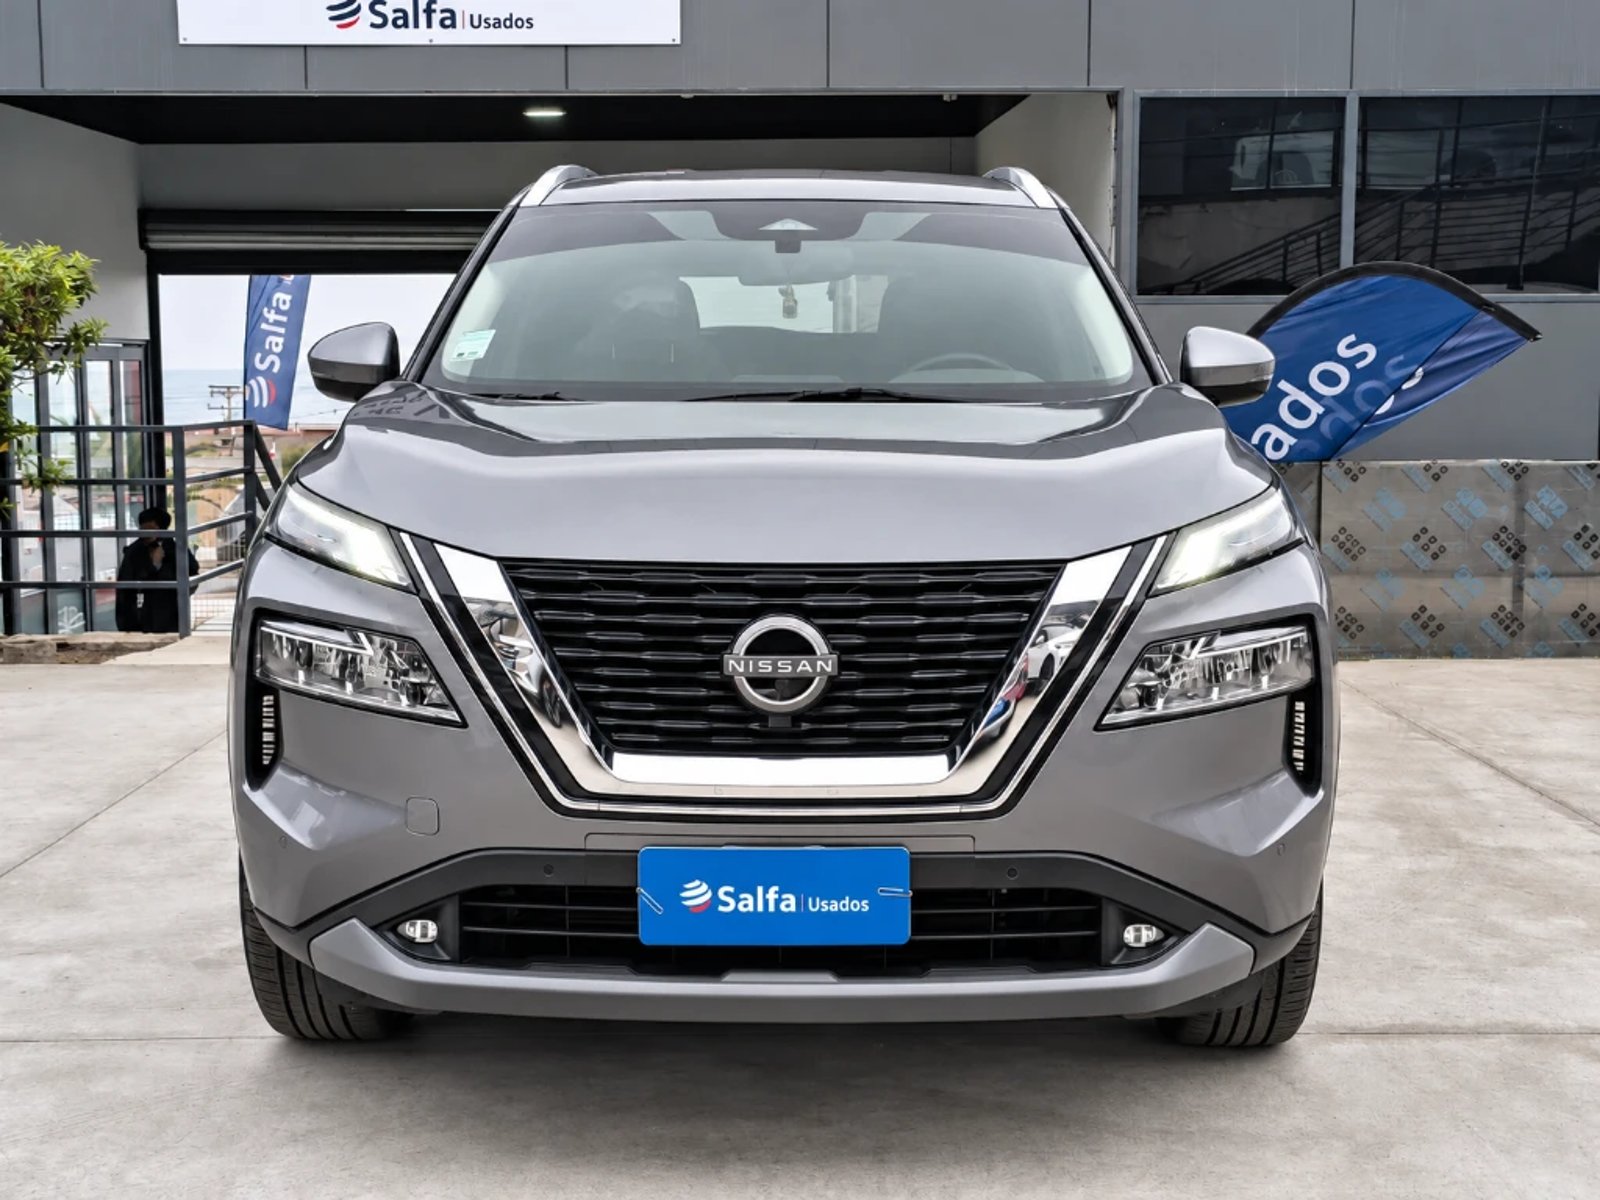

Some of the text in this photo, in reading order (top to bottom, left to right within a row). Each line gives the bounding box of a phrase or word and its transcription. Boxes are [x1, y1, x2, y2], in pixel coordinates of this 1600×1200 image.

[368, 0, 534, 30] Salfa Usados
[254, 290, 293, 374] Salfa
[728, 660, 833, 673] NISSAN
[717, 885, 870, 914] Salfa Usados
